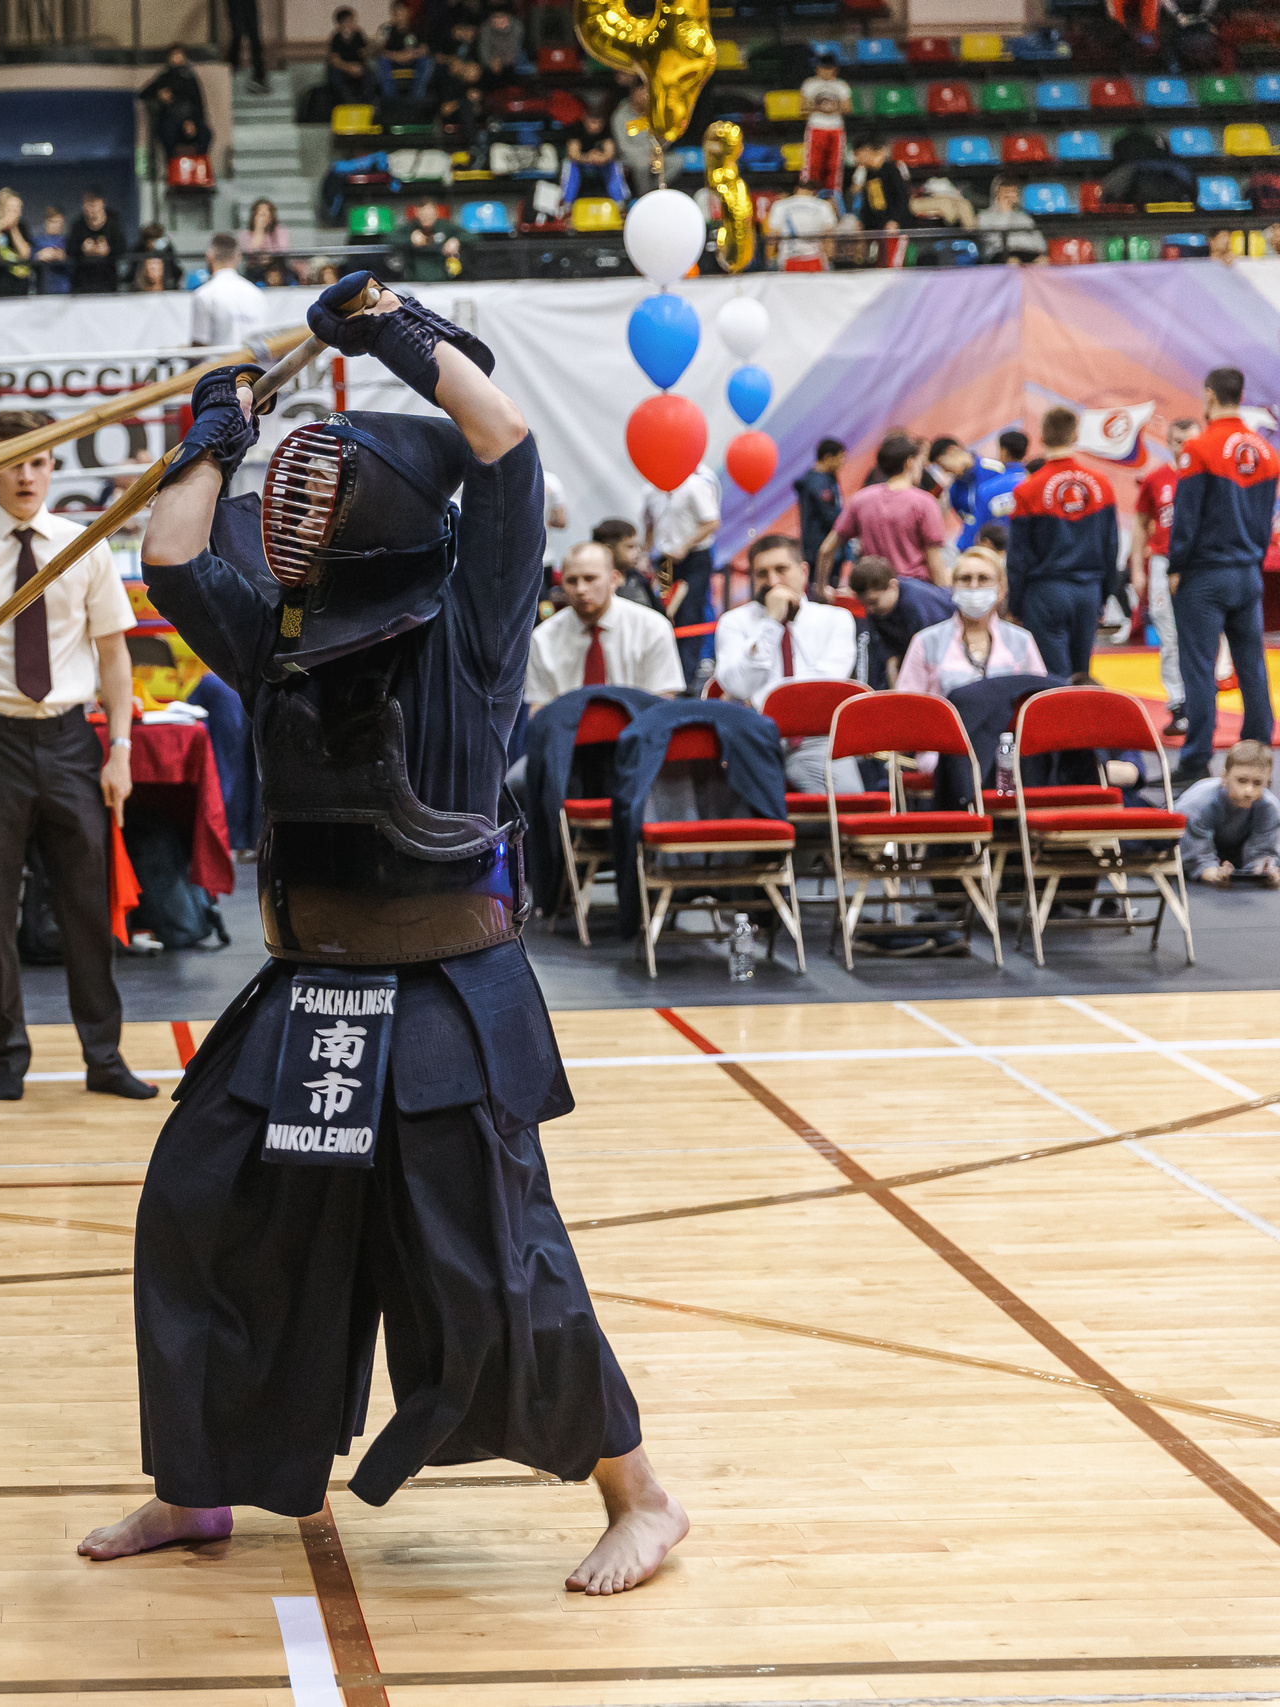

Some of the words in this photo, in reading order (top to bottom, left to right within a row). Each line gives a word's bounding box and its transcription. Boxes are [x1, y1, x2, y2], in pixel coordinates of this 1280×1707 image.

[290, 986, 396, 1016] Y-SAKHALINSK
[302, 1019, 368, 1122] 南市
[265, 1123, 374, 1154] NIKOLENKO
